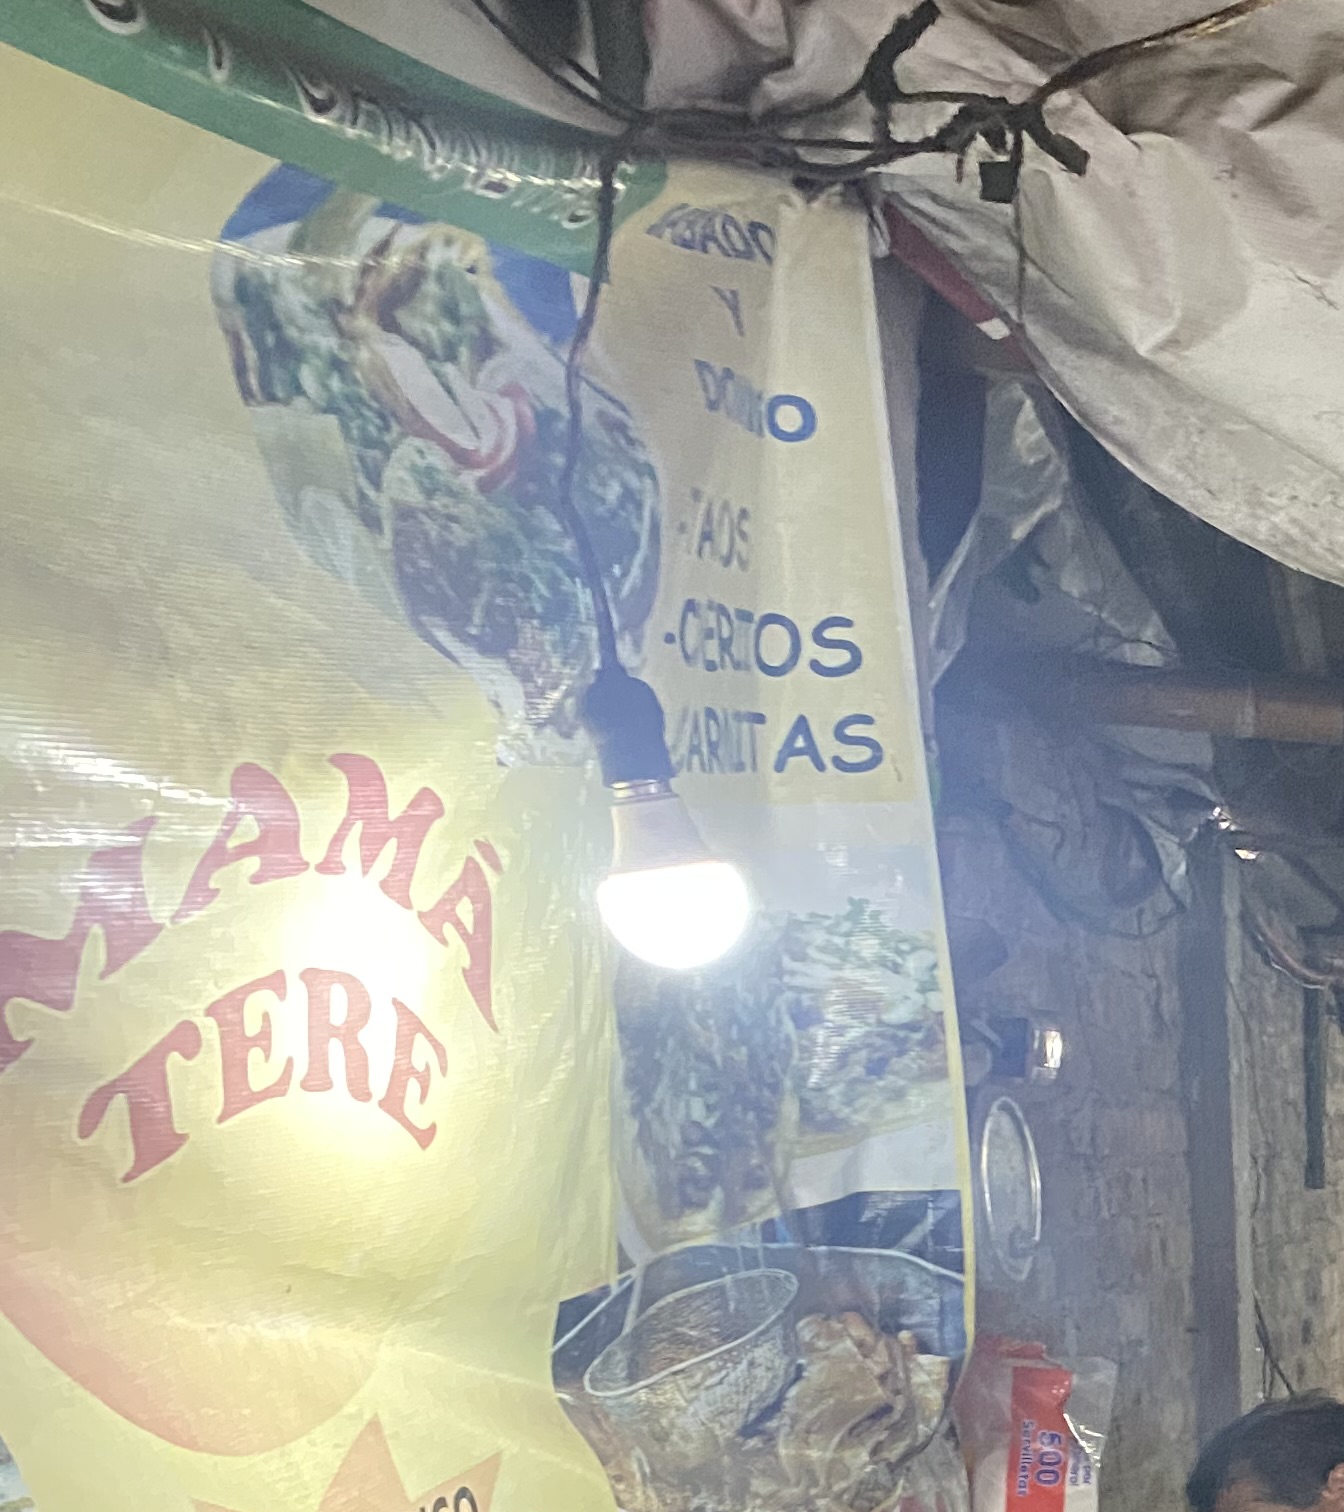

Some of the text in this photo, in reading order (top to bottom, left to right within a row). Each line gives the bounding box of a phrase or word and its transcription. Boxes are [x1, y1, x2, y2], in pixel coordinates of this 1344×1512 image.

[709, 285, 746, 338] Y
[78, 967, 448, 1183] TERE
[1034, 1429, 1064, 1487] 500
